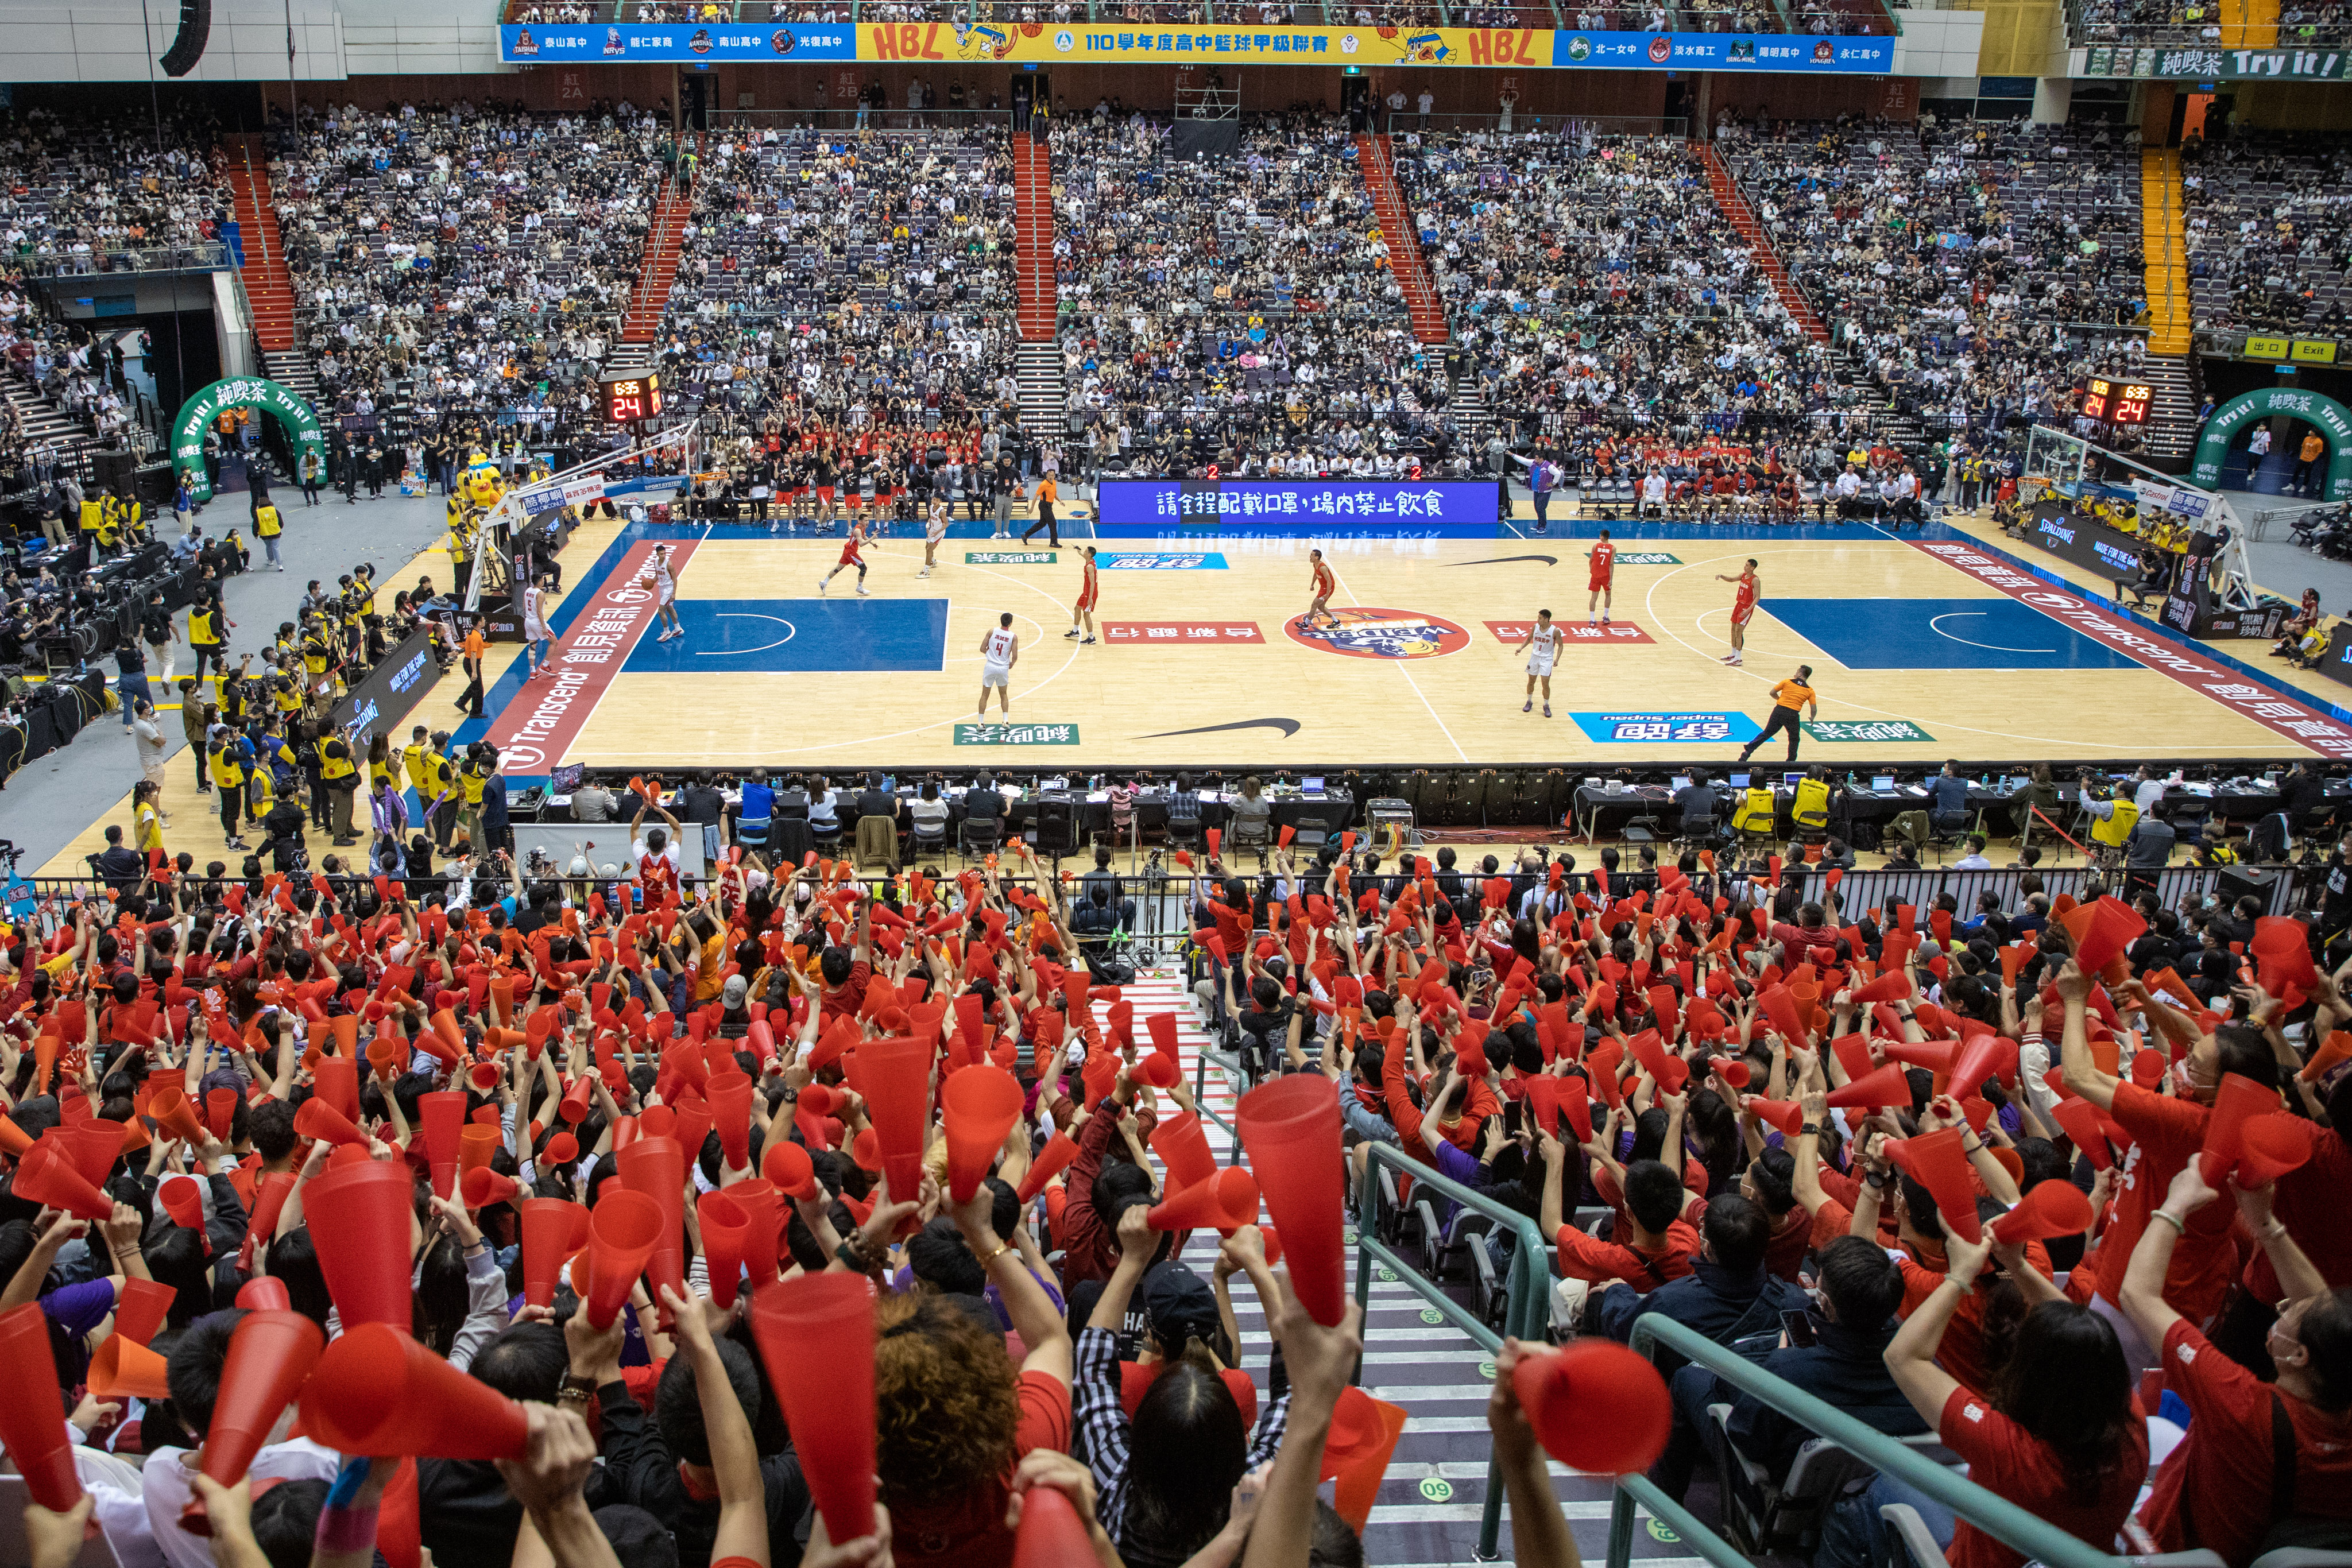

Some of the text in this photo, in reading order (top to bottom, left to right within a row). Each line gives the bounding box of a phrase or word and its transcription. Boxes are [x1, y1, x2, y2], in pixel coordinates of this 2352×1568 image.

[546, 37, 586, 48] 泰山高中
[630, 37, 672, 47] 能仁家商
[688, 40, 714, 48] NANSHAN
[719, 36, 761, 47] 南山高中
[800, 36, 842, 47] 光復高中
[873, 23, 943, 60] HBL
[1086, 33, 1328, 52] 110學年度高中籃球甲級聯賽
[1469, 29, 1536, 65] HBL
[515, 46, 539, 54] TAISHAN
[1596, 44, 1637, 55] 北一女中
[1674, 45, 1715, 56] 淡水商工
[1759, 47, 1800, 58] 陽明高中
[1840, 49, 1880, 60] 永仁高中
[2160, 50, 2222, 76] 純喫茶
[2233, 51, 2338, 77] Try it!
[564, 73, 579, 85] 紅
[840, 72, 854, 84] 紅
[1503, 77, 1518, 89] 紅
[562, 88, 583, 98] 2A
[837, 87, 858, 98] 2B
[1889, 84, 1905, 95] 紅
[1886, 98, 1905, 108] 2E
[2254, 342, 2278, 352] 出口
[2303, 346, 2324, 355] Exit
[215, 380, 268, 407] 純喫茶
[614, 381, 640, 396] 6:35
[2125, 385, 2150, 400] 6:35
[276, 390, 296, 411] Try
[2267, 393, 2313, 412] 純喫茶
[613, 397, 641, 419] 24
[2116, 400, 2144, 421] 24
[2320, 404, 2340, 424] Try
[2216, 411, 2238, 427] Try
[183, 417, 203, 437] Try
[299, 429, 323, 442] 純喫茶
[2206, 433, 2227, 444] 純喫茶
[177, 443, 201, 459] 純喫茶
[1207, 464, 1218, 479] 2
[1411, 466, 1422, 480] 2
[2197, 463, 2218, 474] 純喫茶
[191, 470, 207, 482] 喫茶
[524, 490, 563, 508] 酷椰嶼
[2145, 489, 2169, 501] Castrol
[2172, 492, 2207, 510] 酷椰嶼
[528, 506, 540, 514] KOH
[2169, 502, 2181, 510] KOH
[2038, 518, 2076, 545] SPALDING
[971, 553, 1051, 563] 純喫茶
[2094, 541, 2110, 555] MADE
[2107, 547, 2119, 559] FOR
[2117, 551, 2129, 563] THE
[1108, 557, 1205, 568] 舒跑
[1600, 555, 1606, 566] 7
[1923, 544, 2040, 588] 創見資訊
[516, 564, 524, 580] 小美
[2181, 569, 2193, 595] 小美
[528, 599, 532, 611] 5
[2171, 598, 2187, 613] 黑糖
[2168, 609, 2183, 624] 珍奶
[2242, 613, 2265, 626] 黑糖
[498, 623, 514, 632] 小美
[1108, 625, 1258, 638] 台新銀行
[1314, 626, 1452, 639] WEIDER
[1496, 626, 1642, 638] 台新行
[2239, 626, 2262, 637] 珍奶
[561, 606, 643, 664] 創見資訊
[2061, 607, 2217, 676] Transcend
[996, 642, 1004, 656] 4
[510, 672, 590, 742] Transcend
[962, 725, 1071, 743] 純喫茶
[1611, 722, 1734, 740] 舒跑
[1805, 722, 1920, 740] 純喫茶
[1802, 782, 1825, 791] PHOTOGRAPHER
[1382, 1269, 1395, 1281] 05
[1425, 1310, 1439, 1322] 06
[1423, 1482, 1450, 1496] 09
